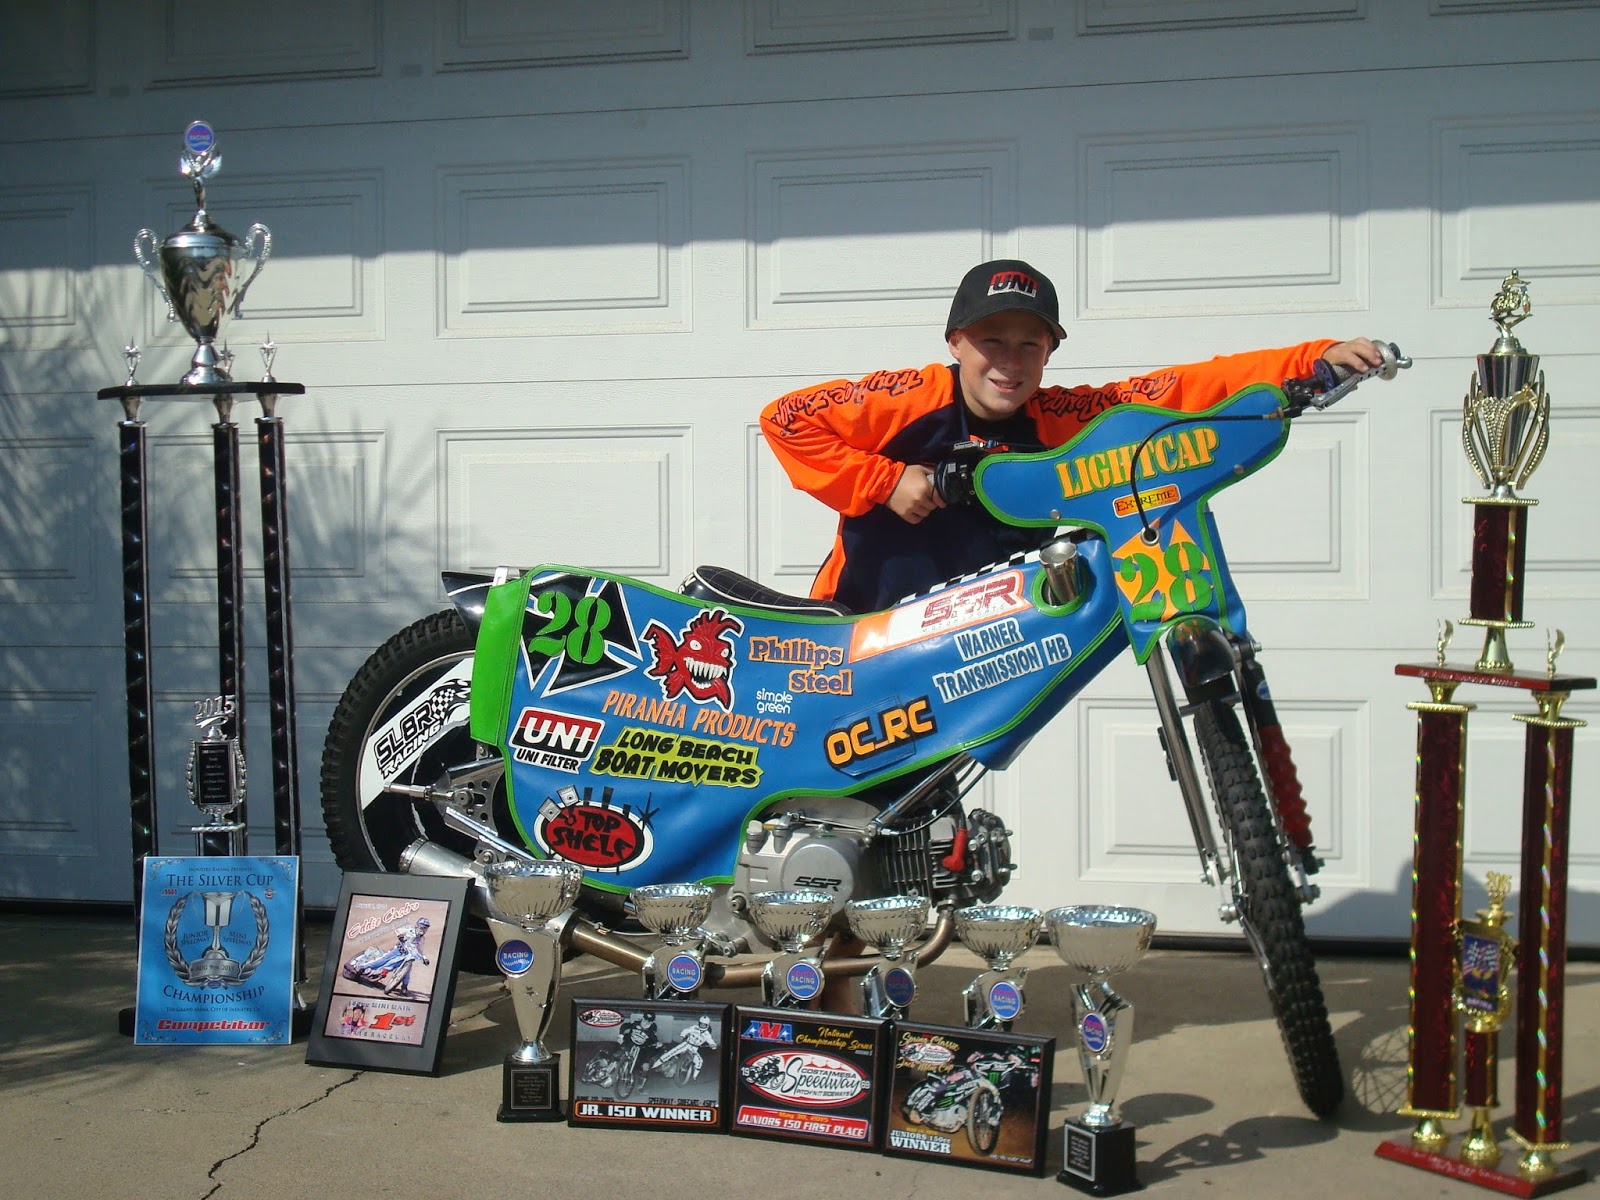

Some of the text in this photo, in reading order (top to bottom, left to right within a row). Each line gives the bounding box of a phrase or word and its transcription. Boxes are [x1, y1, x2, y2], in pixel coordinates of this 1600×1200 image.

[991, 273, 1036, 295] UNI
[1056, 428, 1218, 498] LIGHTCAP
[1114, 490, 1176, 512] EXREME
[1119, 541, 1214, 623] 28
[921, 576, 1017, 628] SSR
[528, 591, 611, 664] 28
[957, 620, 1022, 660] WARNER
[751, 637, 842, 669] Phillips
[935, 636, 1071, 701] TRANSMISSION HB
[790, 671, 852, 694] Steel
[194, 694, 236, 717] 2015
[756, 688, 793, 704] simple
[601, 690, 797, 747] PIRANHA PRODUCTS
[757, 701, 791, 714] green
[523, 716, 593, 753] UNI
[382, 720, 442, 779] RACING
[618, 731, 754, 765] LONG BEACH
[516, 748, 579, 772] UNI FILTER
[596, 749, 758, 787] BOAT MOVERS
[578, 810, 621, 834] TOP
[552, 826, 635, 860] SHELF
[166, 873, 274, 887] THE SILVER CUP
[793, 876, 843, 892] SSR
[347, 917, 382, 939] Eddie
[503, 952, 529, 960] RACING
[672, 967, 696, 976] RACING
[791, 975, 815, 985] RACING
[163, 984, 265, 1004] CHAMPIONSHIP
[157, 1019, 271, 1032] Competitor
[368, 1012, 416, 1031] 1st
[741, 1020, 854, 1043] AMA National
[795, 1034, 873, 1051] Championship Series
[899, 1032, 960, 1052] Spring Classic
[741, 1067, 750, 1077] 19
[780, 1057, 861, 1097] Speedway
[801, 1068, 857, 1079] COSTA MESA
[580, 1104, 712, 1122] JR. 150 WINNER
[741, 1114, 781, 1127] JUNIORS
[783, 1119, 801, 1130] 150
[803, 1121, 832, 1134] FIRST
[833, 1125, 864, 1138] PLACE
[890, 1129, 927, 1140] JUNIORS
[890, 1136, 951, 1154] WINNER
